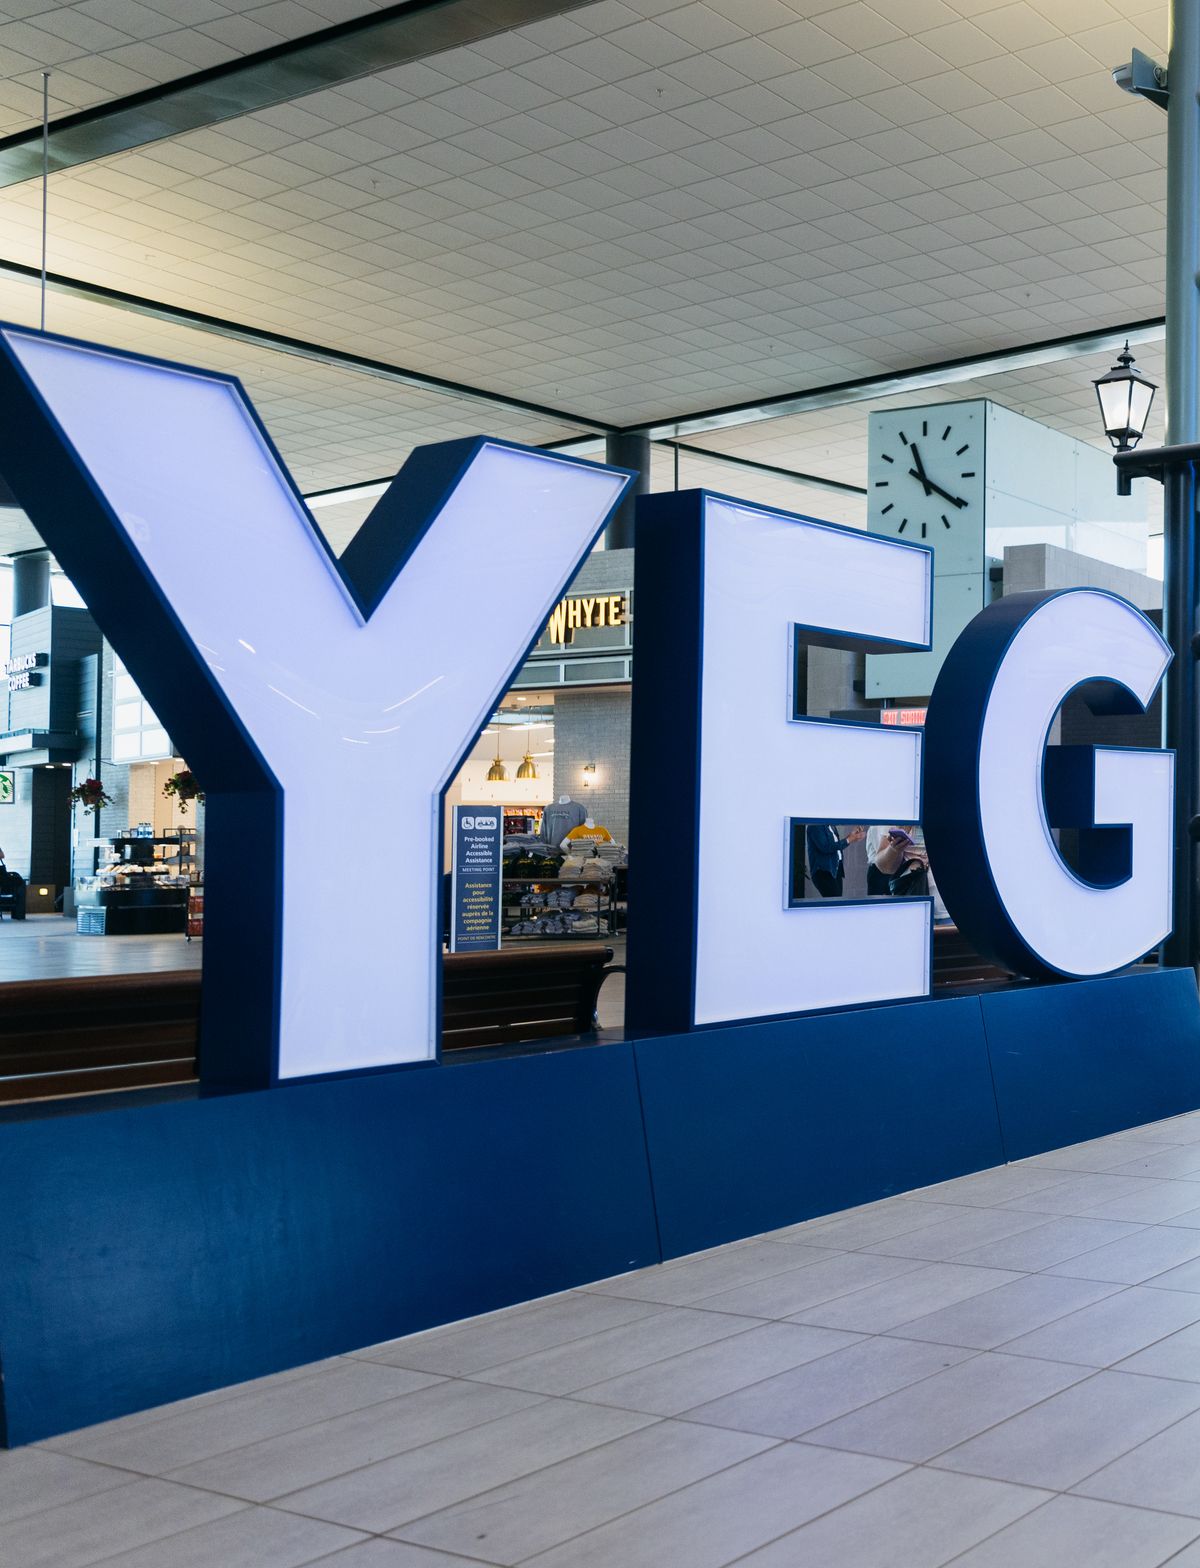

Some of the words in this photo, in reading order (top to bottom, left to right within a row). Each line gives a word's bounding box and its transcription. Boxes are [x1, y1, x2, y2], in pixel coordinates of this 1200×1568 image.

[550, 596, 621, 644] WHYTE
[0, 321, 1177, 1088] YEG
[8, 672, 30, 691] COFFEE
